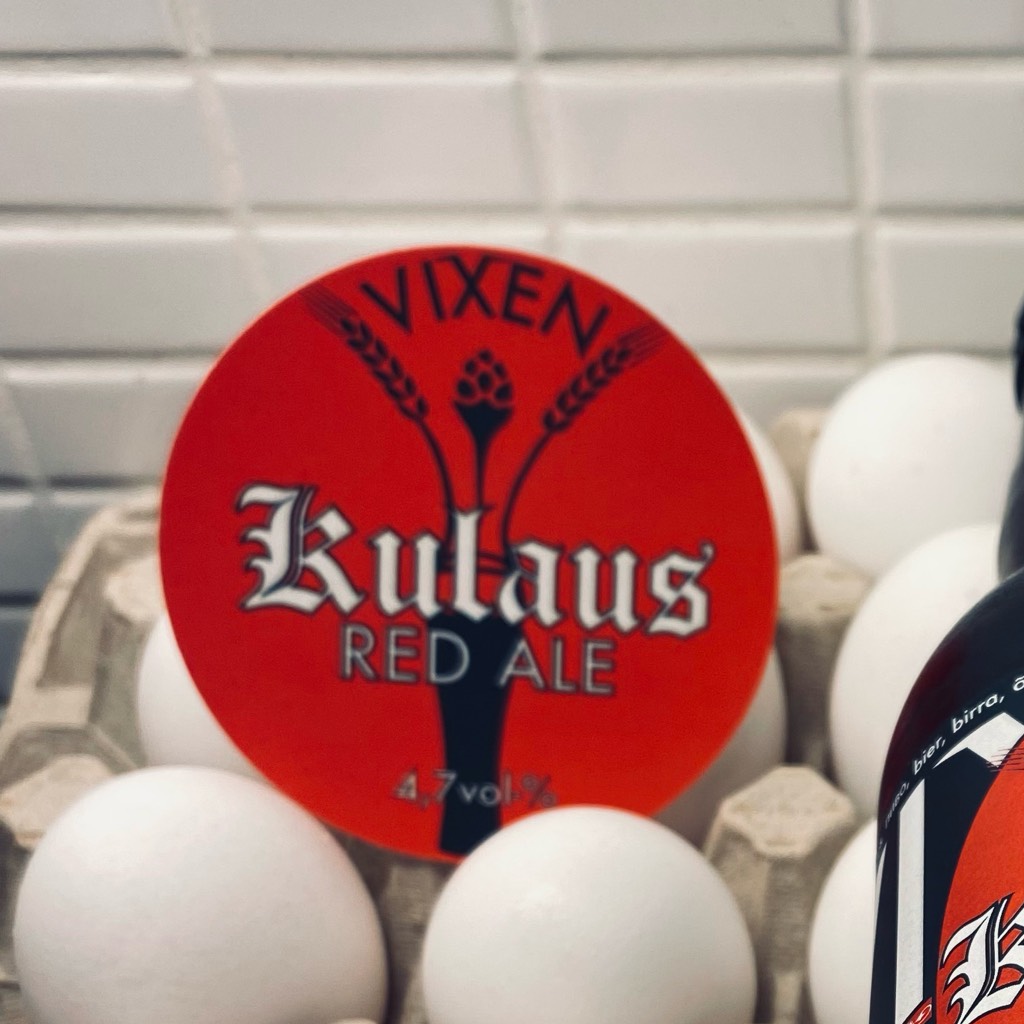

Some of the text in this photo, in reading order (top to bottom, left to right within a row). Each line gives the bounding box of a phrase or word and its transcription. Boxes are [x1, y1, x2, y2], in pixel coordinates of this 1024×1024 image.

[361, 253, 611, 358] VIXEN
[235, 480, 715, 638] Kulaus
[338, 624, 617, 696] RED ALE
[913, 736, 946, 775] bier,
[951, 693, 1004, 734] birra,
